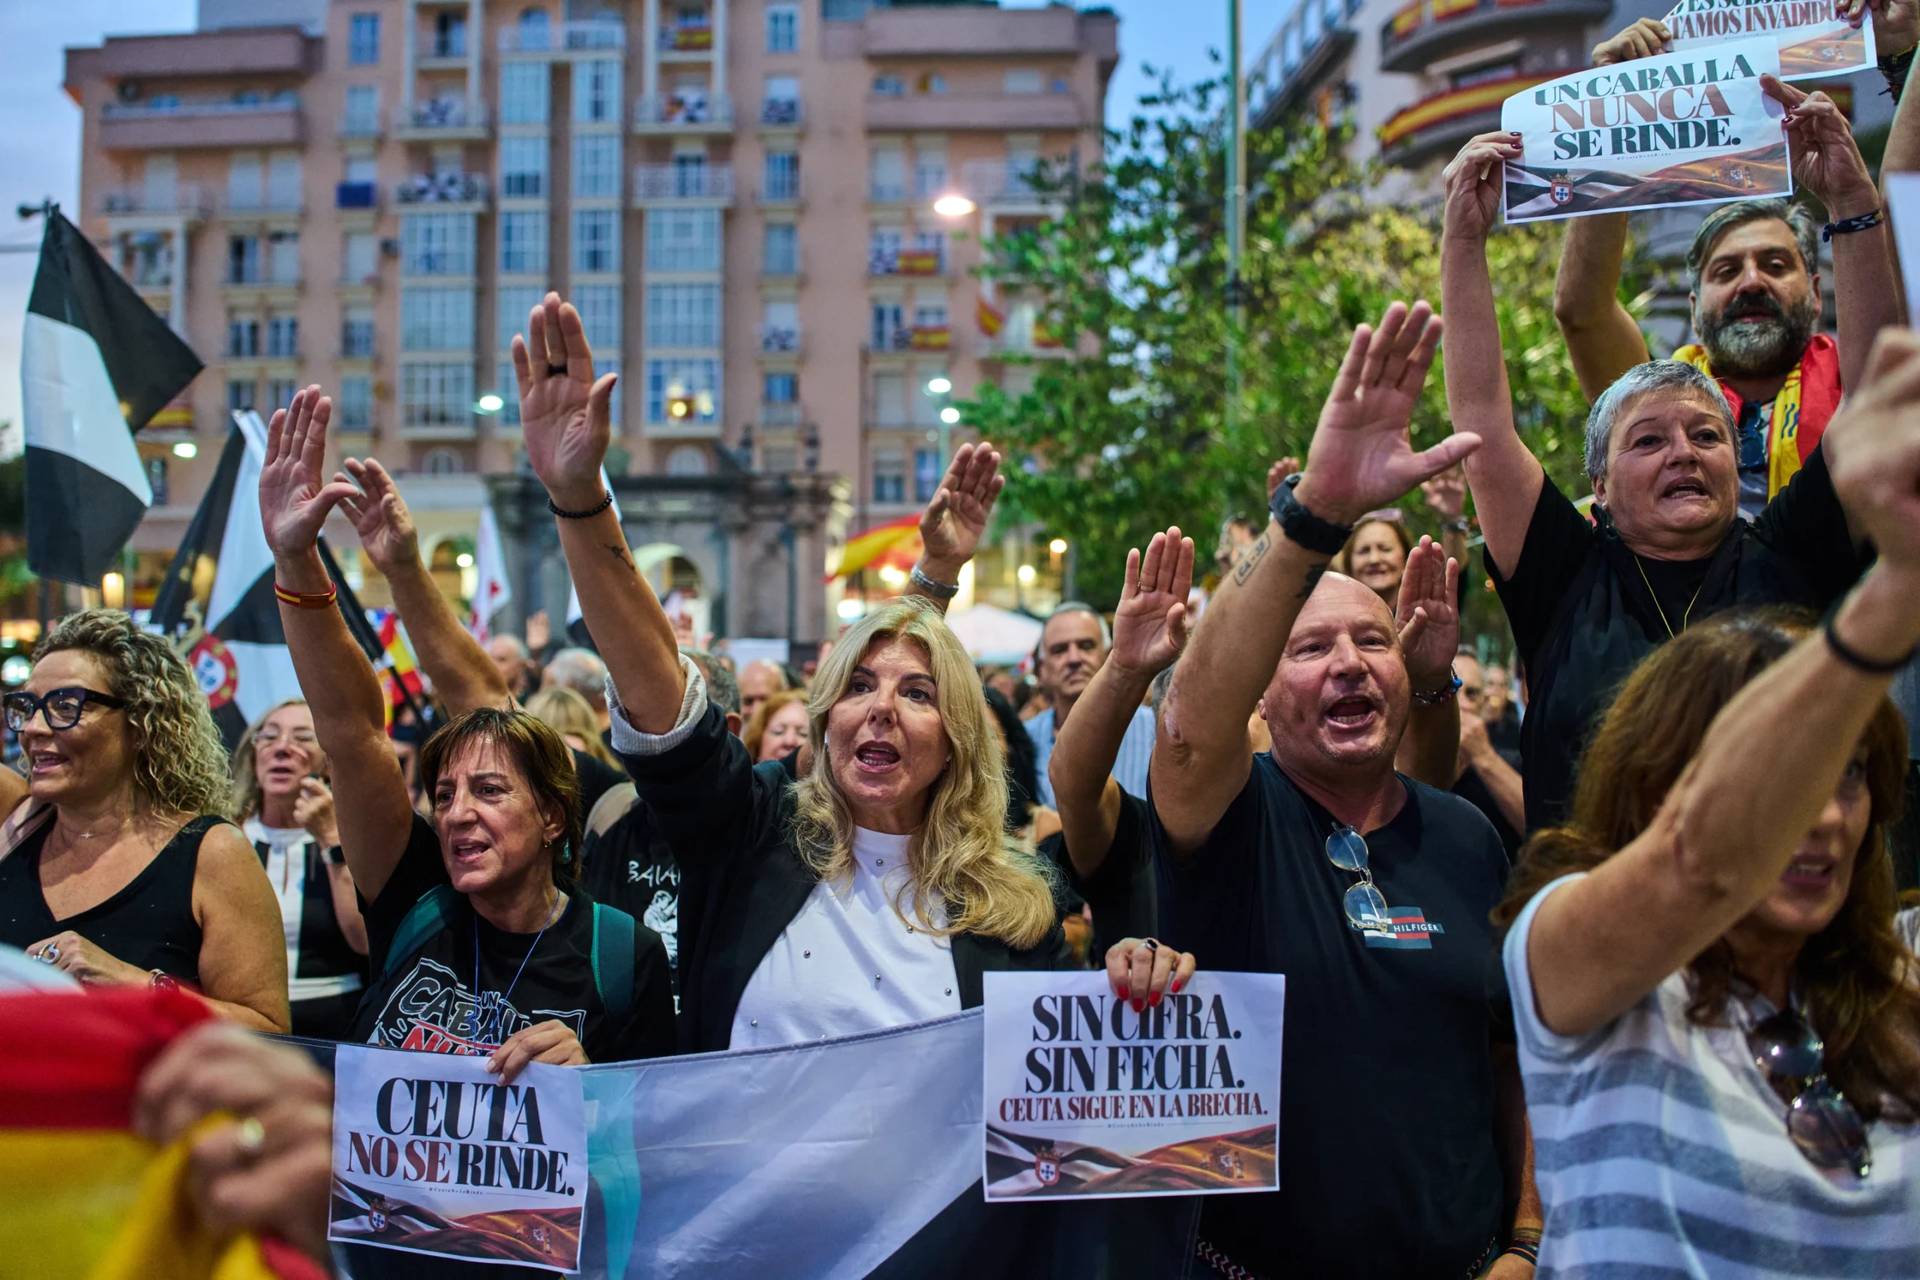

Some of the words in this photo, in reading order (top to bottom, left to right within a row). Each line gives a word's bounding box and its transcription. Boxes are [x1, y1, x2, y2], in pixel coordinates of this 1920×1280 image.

[1669, 8, 1742, 40] TAMOS
[1745, 0, 1838, 32] INVADIDO
[1534, 81, 1581, 106] UN
[1586, 54, 1756, 98] CABALLA
[1550, 84, 1735, 133] NUNCA
[1553, 129, 1602, 161] SE
[1611, 118, 1741, 155] RINDE.
[1393, 923, 1439, 933] HILFIGER
[399, 977, 533, 1044] CABAL
[480, 991, 500, 1009] UN
[1032, 994, 1106, 1042] SIN
[1111, 994, 1242, 1041] CIFRA.
[1025, 1047, 1098, 1093] SIN
[1106, 1044, 1245, 1092] FECHA.
[376, 1077, 547, 1146] CEUTA
[999, 1098, 1065, 1122] CEUTA
[1067, 1096, 1126, 1121] SIGUE
[1129, 1095, 1155, 1119] EN
[1159, 1094, 1184, 1118] LA
[1187, 1093, 1268, 1117] BRECHA.
[346, 1131, 399, 1178] NO
[403, 1139, 452, 1184] SE
[455, 1143, 575, 1197] RINDE.
